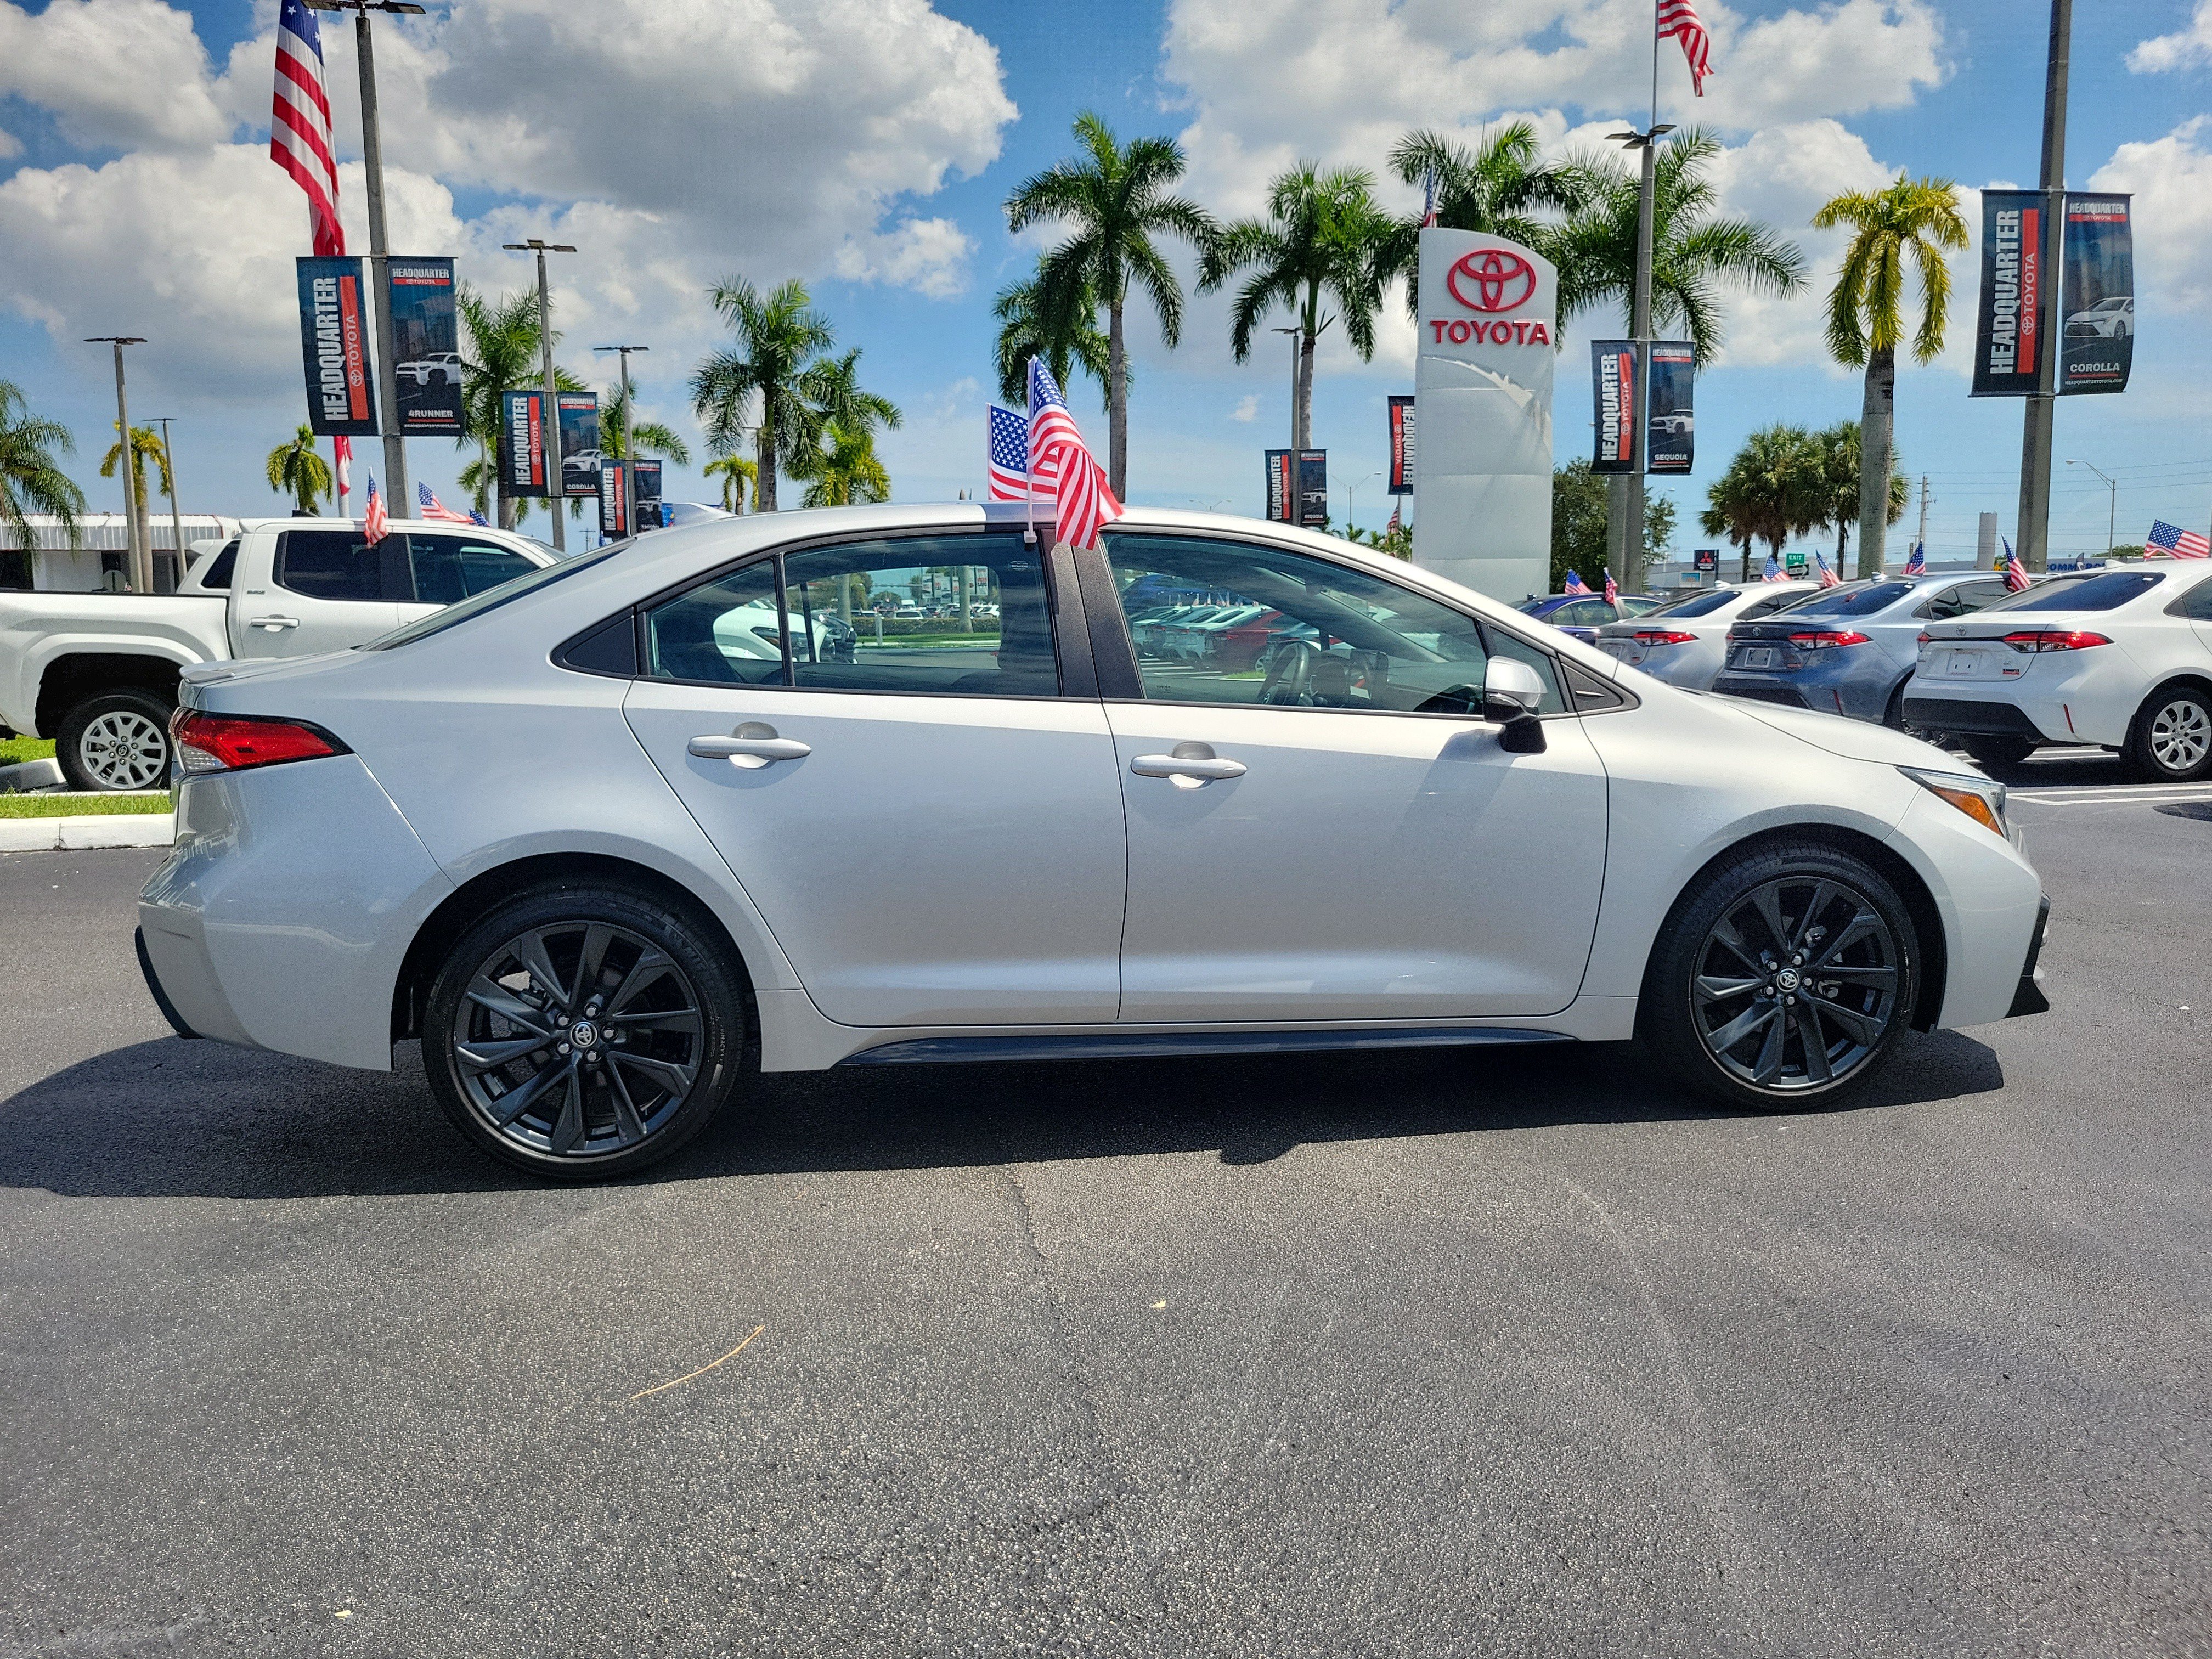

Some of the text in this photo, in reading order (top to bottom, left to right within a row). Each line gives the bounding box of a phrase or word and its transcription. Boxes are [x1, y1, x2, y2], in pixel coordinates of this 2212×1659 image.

[2069, 202, 2126, 215] HEADQUARTER
[392, 268, 450, 279] HEADQUARTER
[1989, 210, 2021, 374] HEADQUARTER
[2023, 253, 2035, 313] TOYOTA
[313, 278, 349, 420] HEADQUARTER
[345, 314, 360, 366] TOYOTA
[1430, 320, 1550, 345] TOYOTA
[2069, 362, 2120, 373] COROLLA
[408, 409, 453, 417] 4RUNNER
[531, 420, 540, 453] TOYOTA
[1600, 354, 1621, 461] HEADQUARTER
[512, 397, 531, 486] HEADQUARTER
[1402, 405, 1415, 485] HEADQUARTER
[603, 467, 616, 531] HEADQUARTER
[1271, 456, 1283, 520] HEADQUARTER
